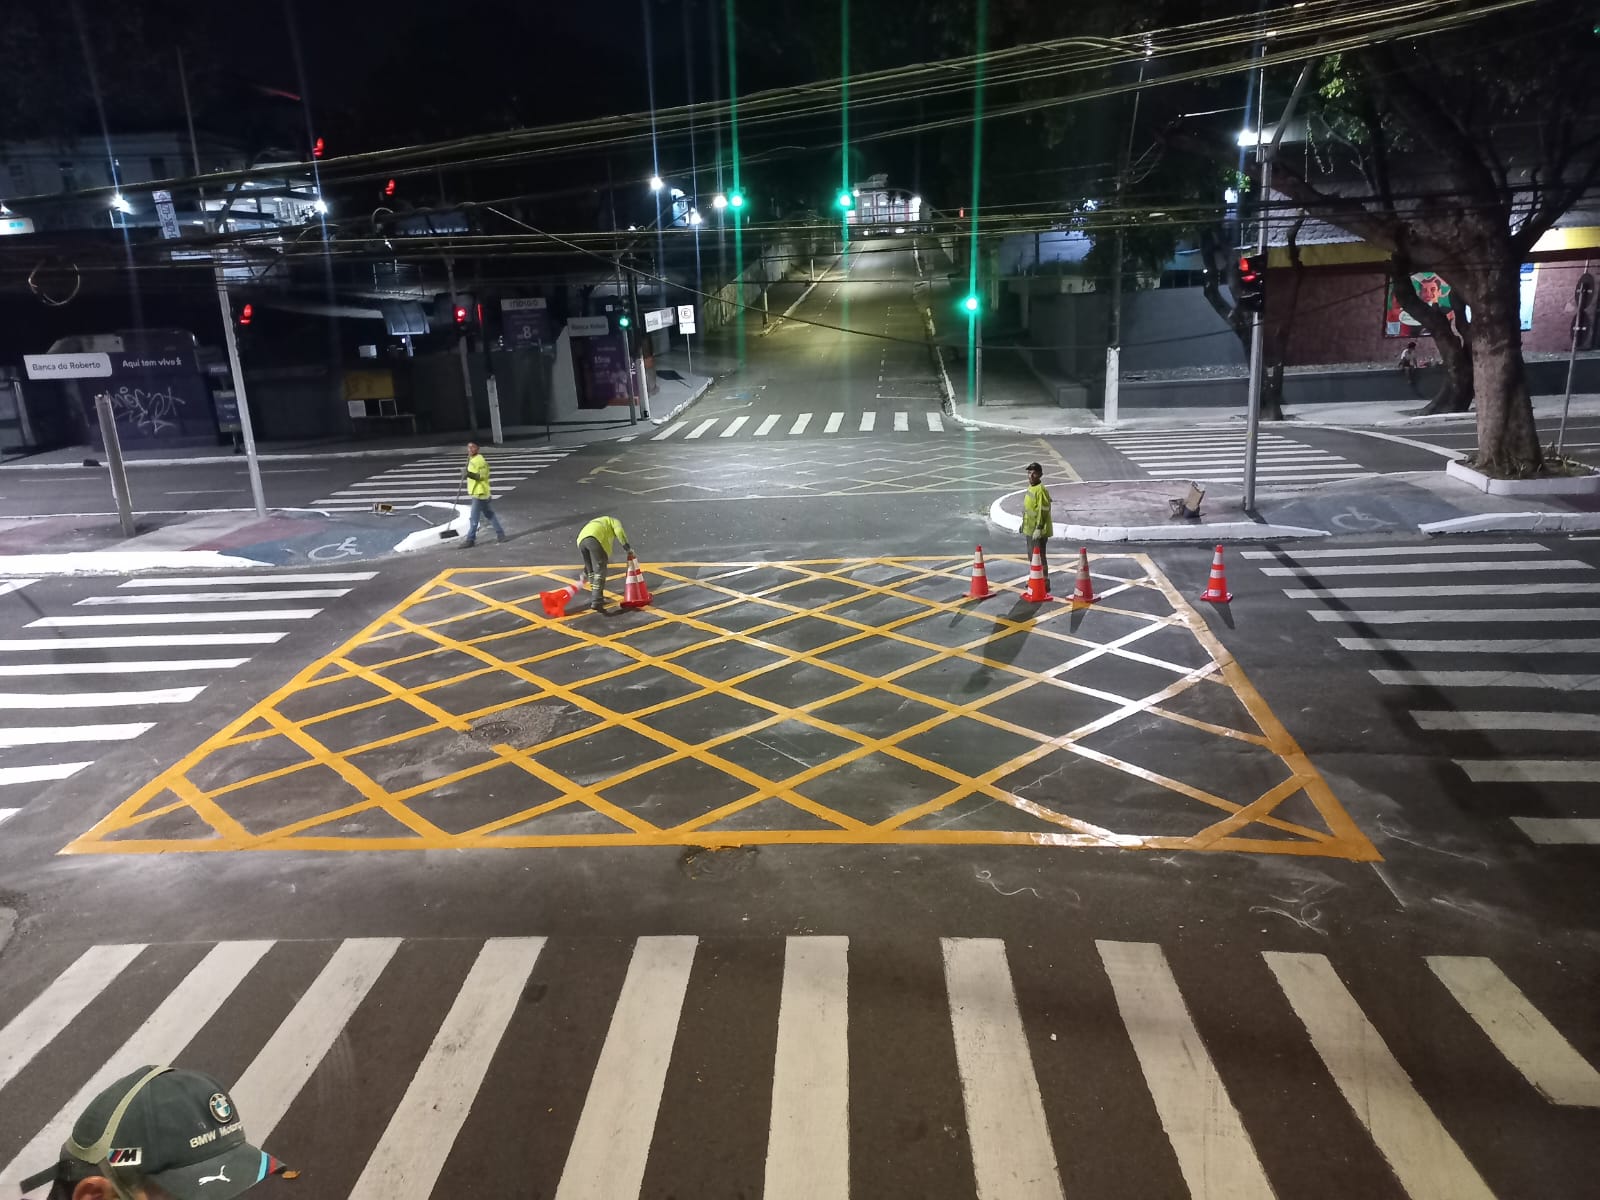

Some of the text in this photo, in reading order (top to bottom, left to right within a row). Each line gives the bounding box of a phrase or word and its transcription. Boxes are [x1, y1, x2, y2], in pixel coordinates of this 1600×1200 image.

[32, 363, 56, 371] Banca
[70, 361, 101, 369] Roberto
[122, 359, 140, 369] Aqui
[141, 359, 157, 367] tem
[190, 1129, 216, 1148] BMW
[117, 1149, 137, 1163] M
